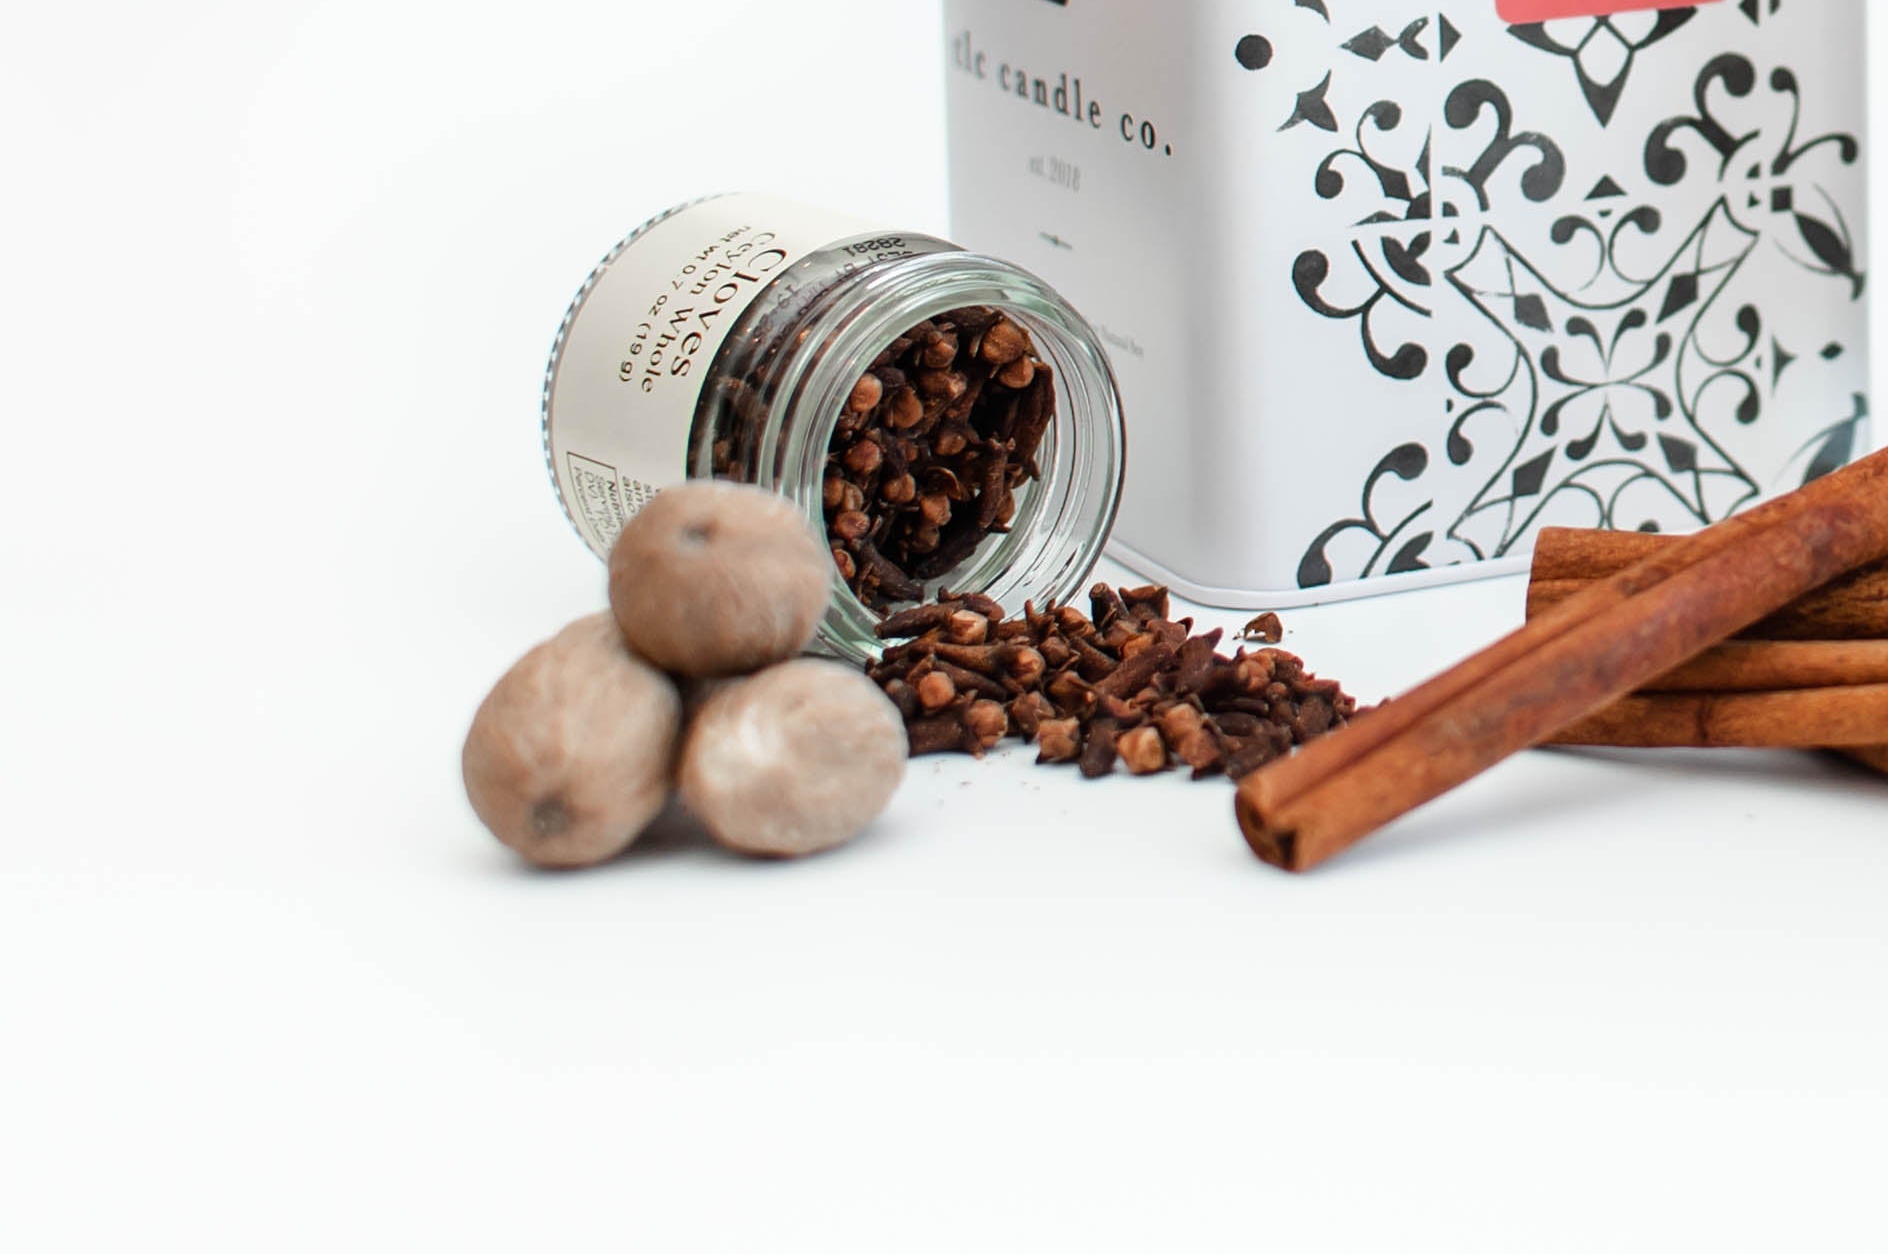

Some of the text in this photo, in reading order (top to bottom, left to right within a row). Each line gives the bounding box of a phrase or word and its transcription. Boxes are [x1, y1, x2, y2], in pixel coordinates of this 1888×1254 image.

[953, 31, 1173, 156] tlc candle co.
[642, 232, 776, 393] Ceylon Whole
[649, 294, 668, 316] oz
[670, 248, 787, 377] Cloves
